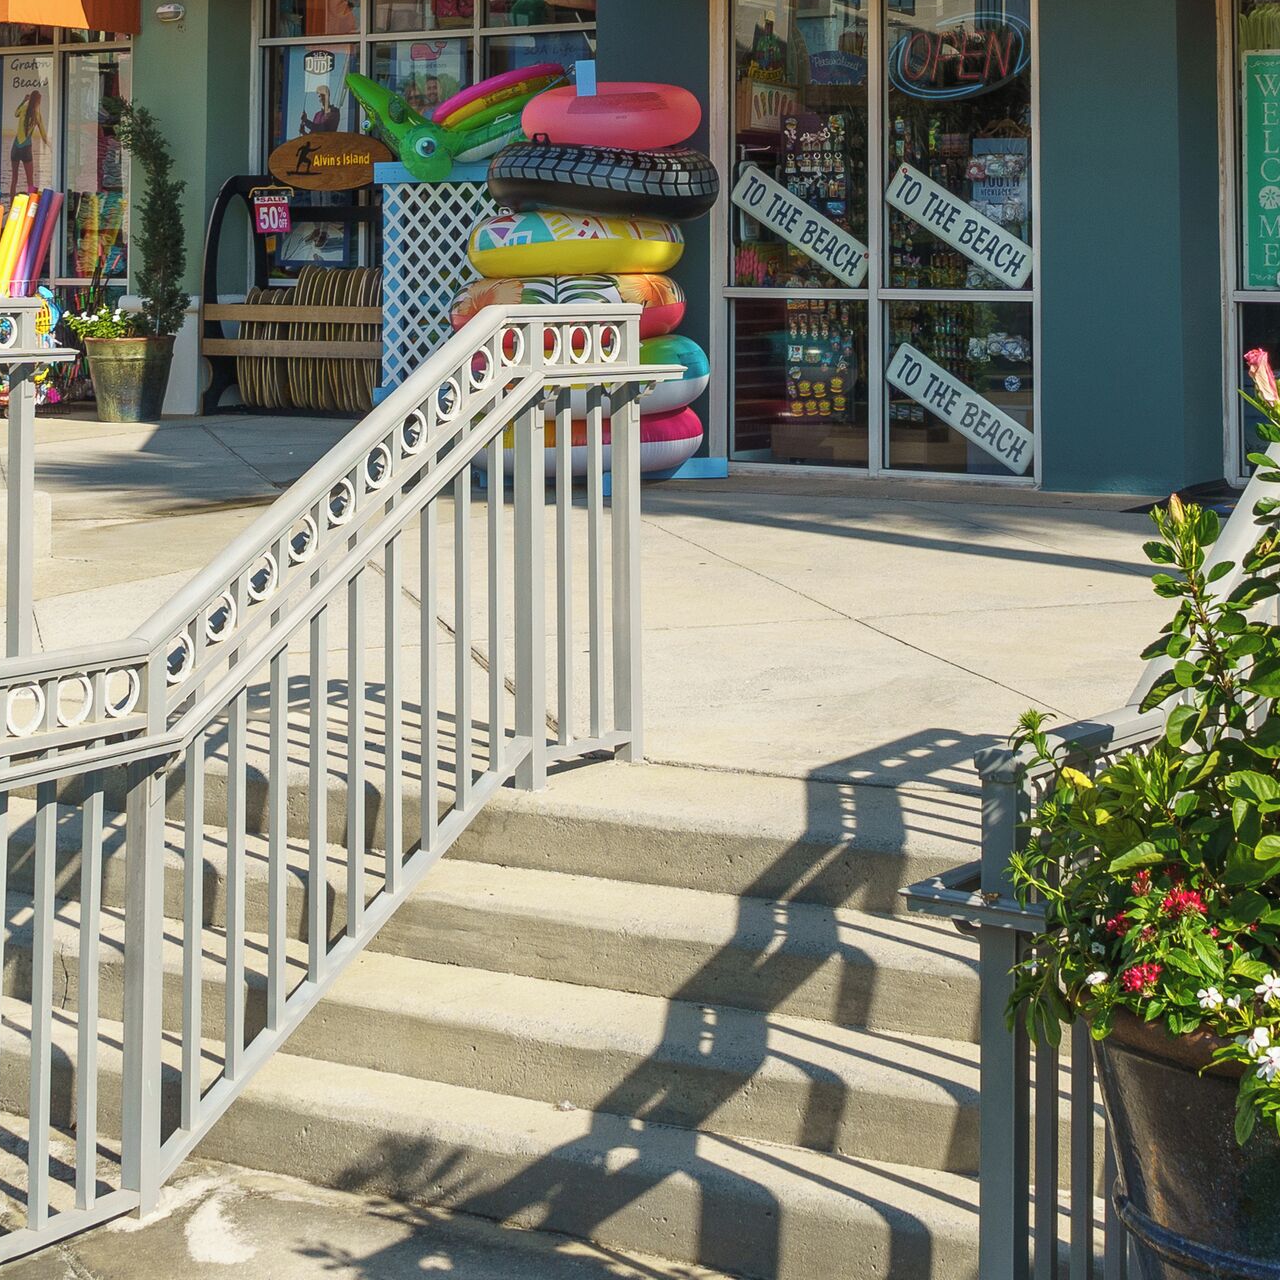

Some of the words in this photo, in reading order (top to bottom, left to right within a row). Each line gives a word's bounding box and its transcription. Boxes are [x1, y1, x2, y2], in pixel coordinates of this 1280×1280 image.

[305, 55, 333, 74] DUDE
[312, 51, 329, 60] HEY
[904, 31, 1013, 81] OPEN
[13, 76, 49, 89] Beach
[313, 154, 341, 167] Alvin's
[342, 151, 370, 166] Island
[278, 218, 288, 228] OFF
[742, 176, 767, 206] TO
[765, 193, 803, 234] THE
[800, 220, 862, 277] BEACH
[895, 174, 922, 205] TO
[922, 191, 961, 233] THE
[958, 219, 1027, 277] BEACH
[896, 353, 922, 386] TO
[923, 372, 962, 416] THE
[960, 401, 1028, 463] BEACH
